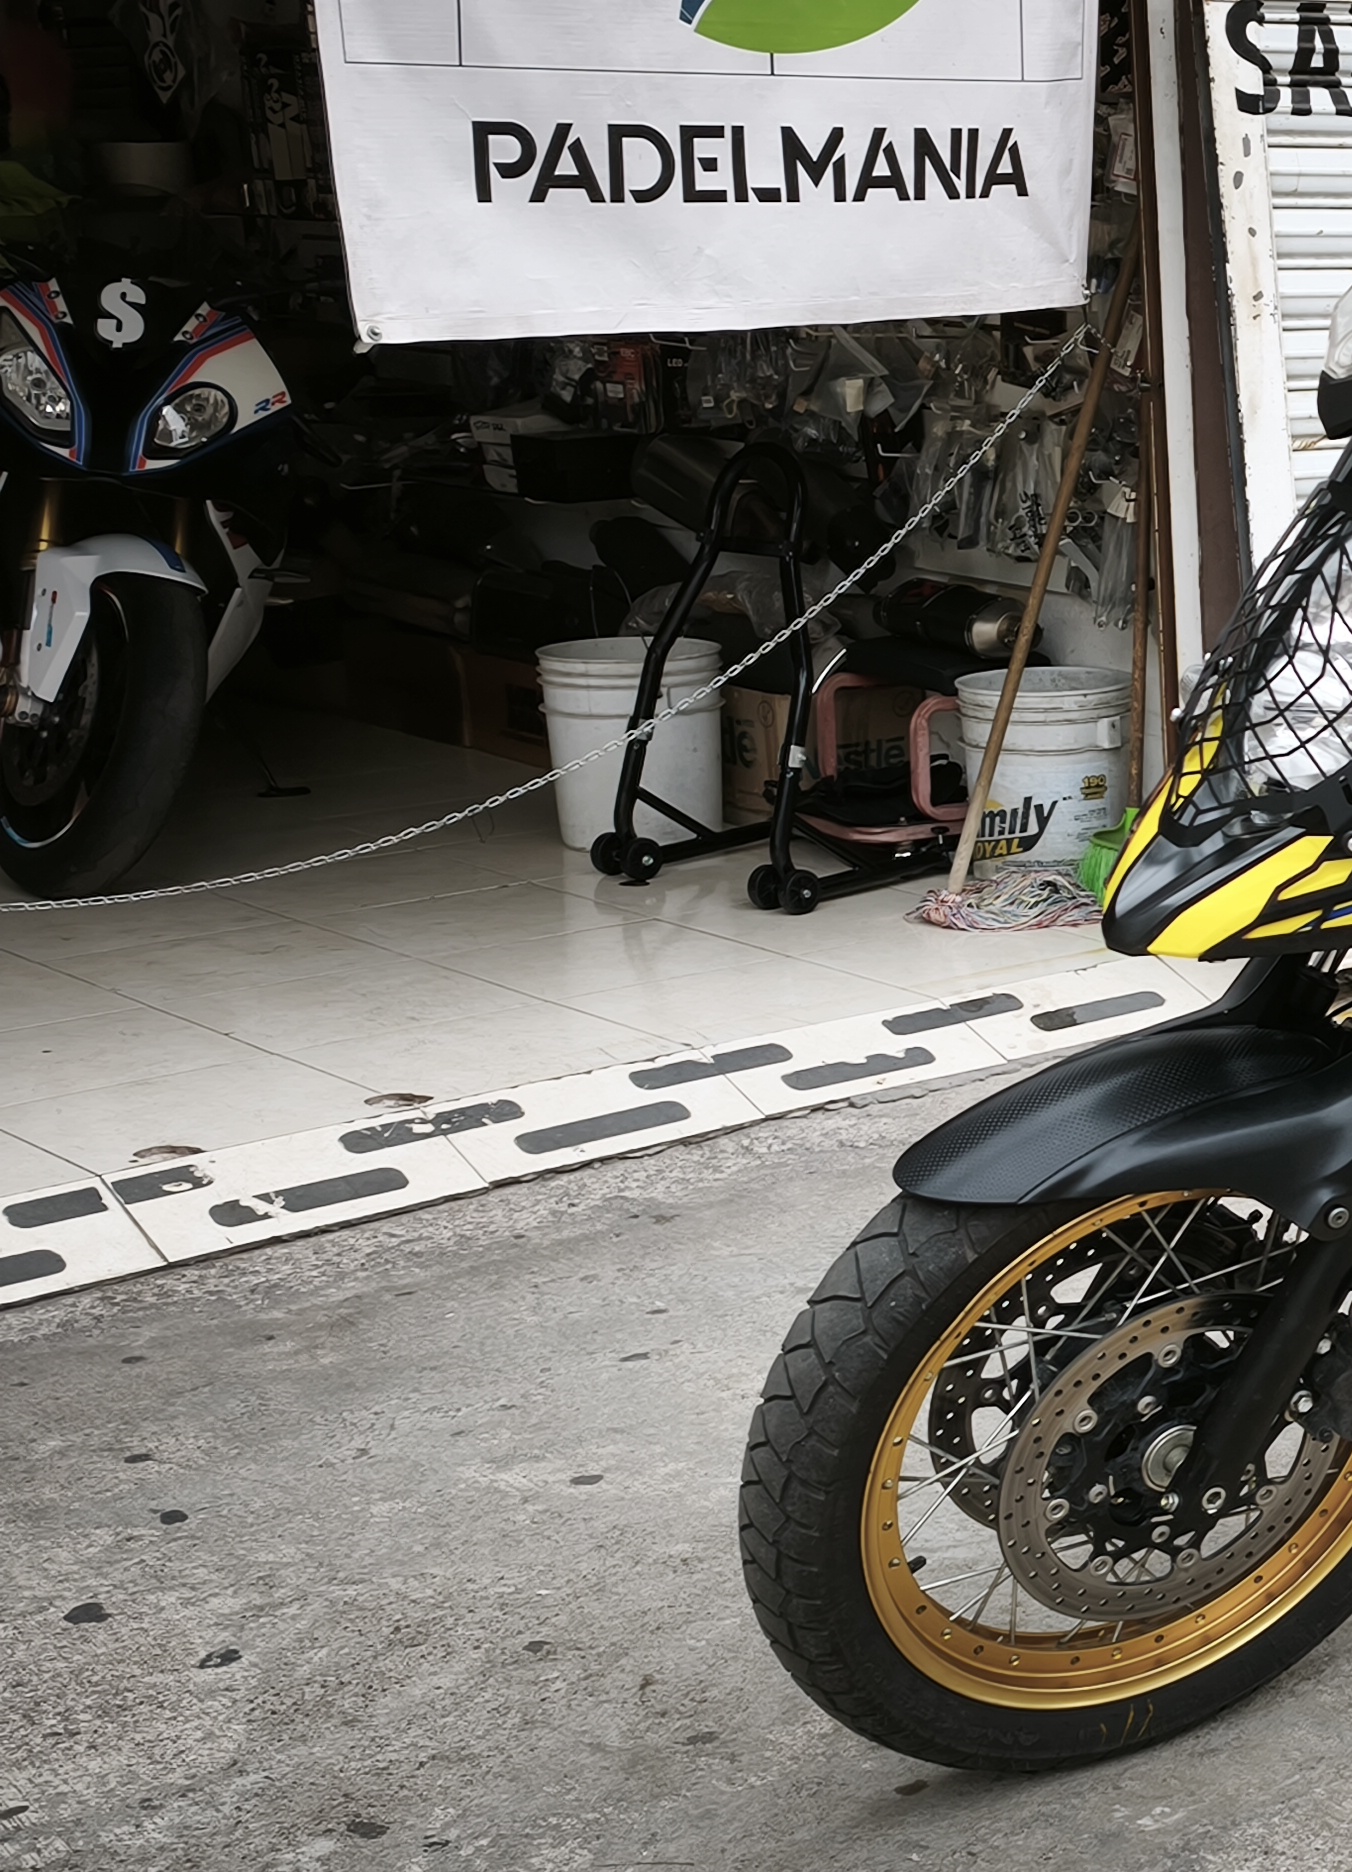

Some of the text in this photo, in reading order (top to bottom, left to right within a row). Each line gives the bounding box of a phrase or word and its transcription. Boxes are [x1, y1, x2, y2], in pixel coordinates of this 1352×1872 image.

[472, 120, 1029, 203] PADELMANIA
[1081, 774, 1107, 788] 190
[979, 796, 1058, 838] mily
[975, 838, 1024, 859] OYAL
